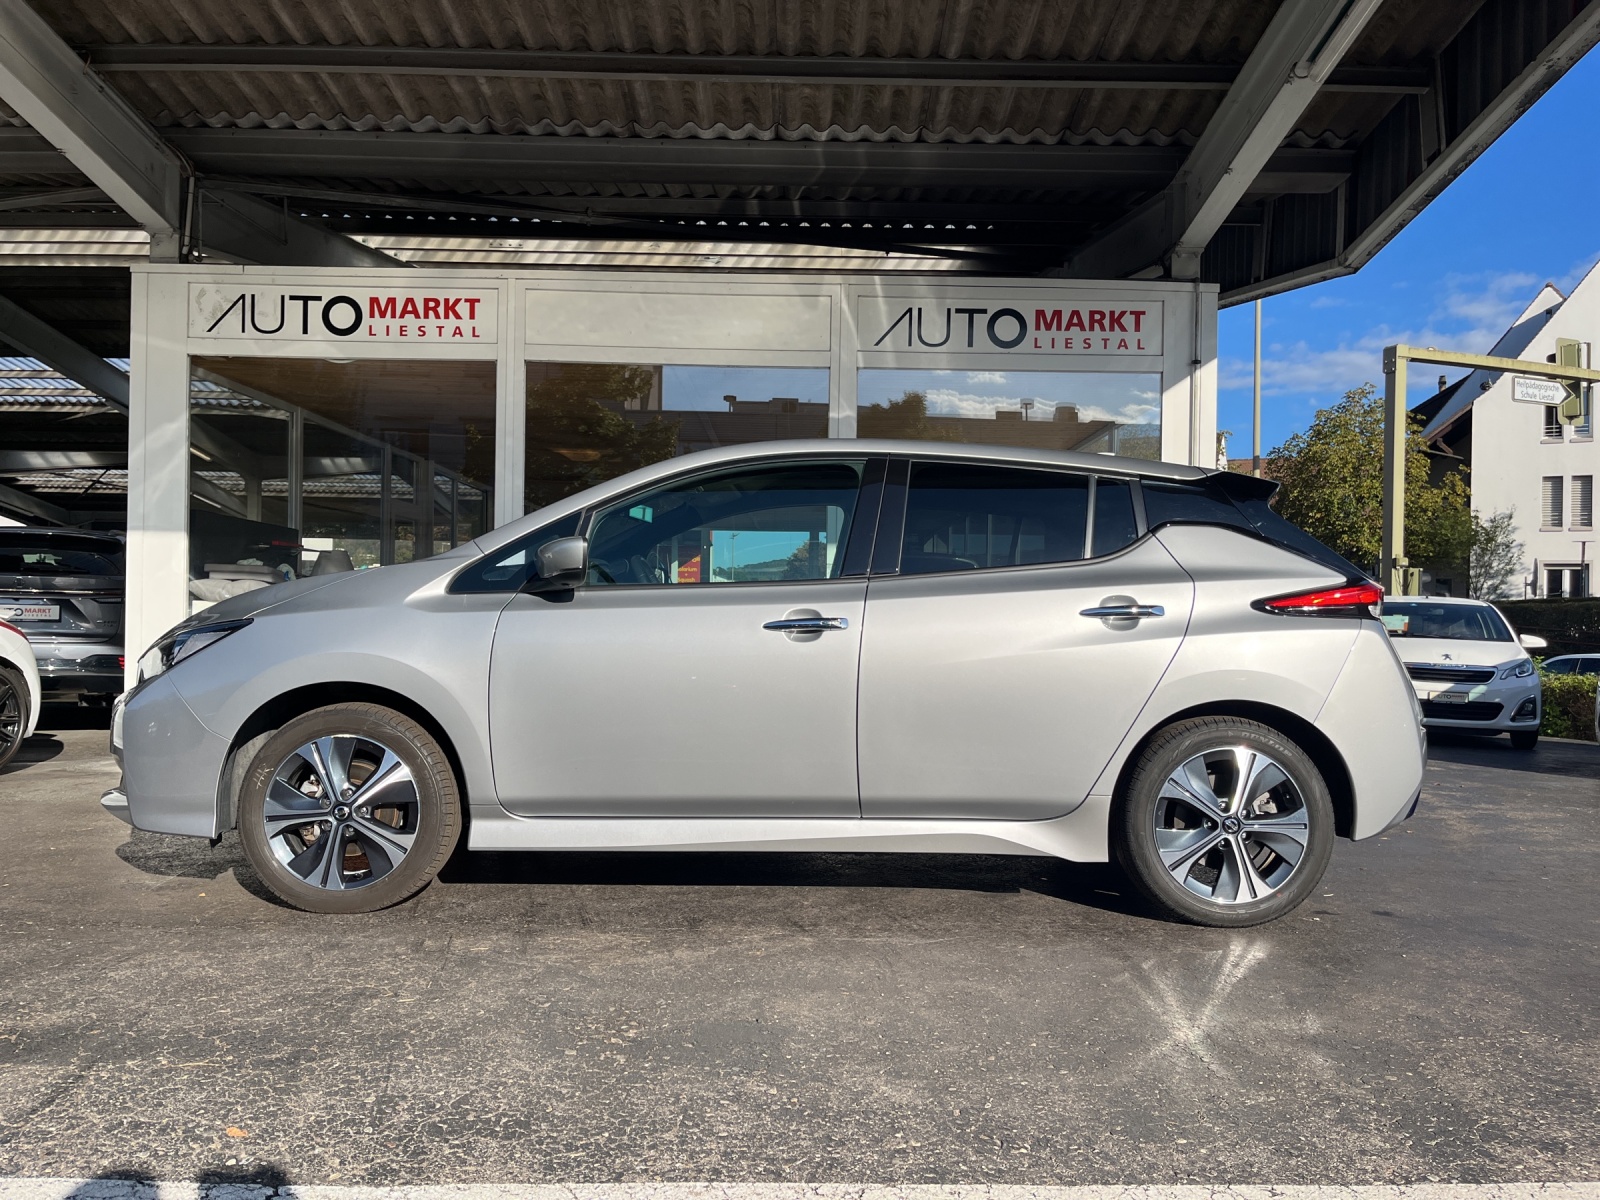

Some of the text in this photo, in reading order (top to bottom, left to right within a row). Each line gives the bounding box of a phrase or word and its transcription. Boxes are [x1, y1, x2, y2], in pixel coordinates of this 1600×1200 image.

[206, 294, 480, 337] AUTO MARKT
[368, 325, 480, 338] LIESTAL
[873, 307, 1146, 349] AUTO MARKT
[1034, 337, 1146, 350] LIESTAL
[1516, 380, 1560, 392] Heilpädagogische
[1521, 391, 1555, 401] Schule Liestal
